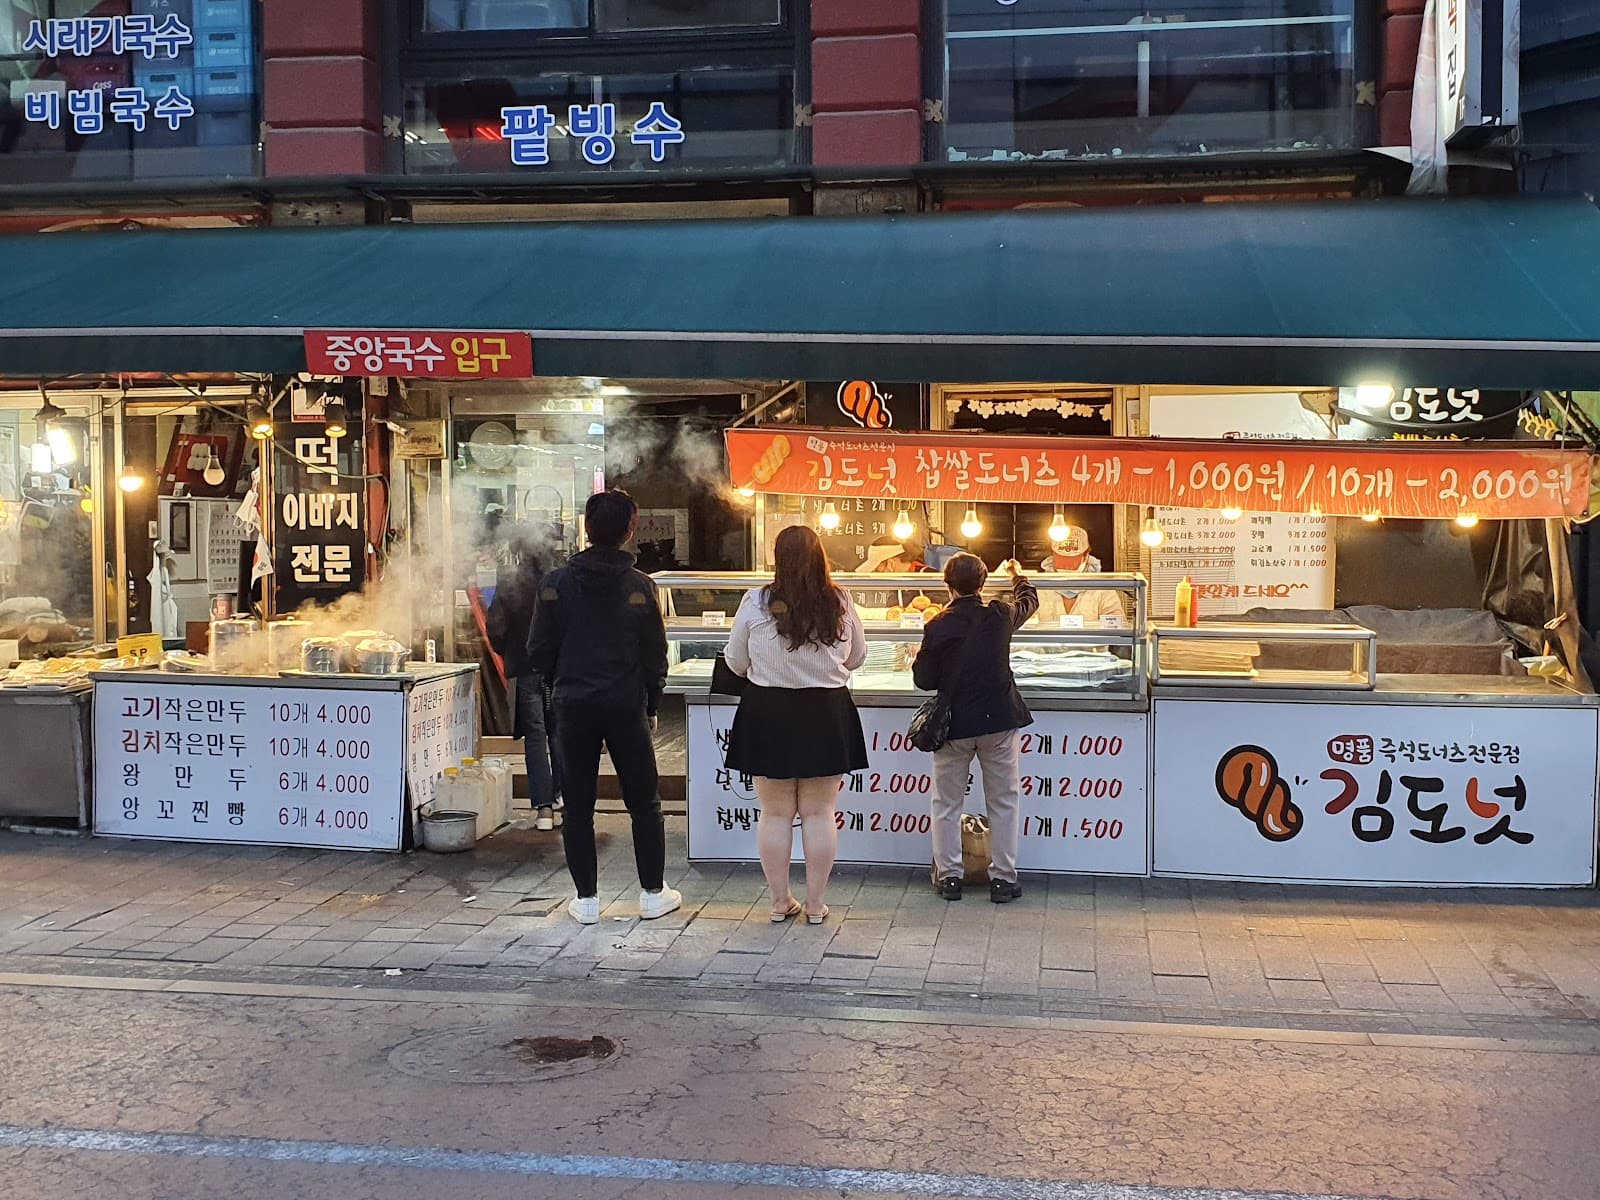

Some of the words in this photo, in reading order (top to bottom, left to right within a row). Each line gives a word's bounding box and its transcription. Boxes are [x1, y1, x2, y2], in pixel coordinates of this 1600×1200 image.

[23, 14, 193, 59] 시래기국수
[324, 336, 445, 372] 중앙국수
[450, 337, 512, 373] 입구
[295, 436, 339, 486] 떡
[805, 455, 897, 494] 김도넛
[915, 449, 1059, 491] 찹쌀도너츠
[1071, 454, 1121, 487] 4개
[1165, 458, 1286, 501] 1,000원
[1326, 465, 1393, 498] 10개
[1439, 464, 1573, 506] 2,000원
[282, 492, 359, 530] 이바지
[290, 545, 352, 582] 전문
[120, 695, 248, 724] 고기작은만두
[268, 701, 309, 725] 10개
[316, 704, 372, 725] 4.000
[121, 729, 248, 758] 김치작은만두
[268, 737, 309, 760] 10개
[316, 738, 371, 760] 4.000
[872, 731, 914, 752] 1.00
[1019, 733, 1052, 755] 2개
[1060, 734, 1123, 757] 1.000
[1331, 738, 1373, 763] 명품
[1378, 737, 1521, 764] 즉석도너츠전문점
[278, 771, 309, 794] 6개
[315, 772, 370, 794] 4.000
[838, 773, 863, 793] 개
[869, 773, 932, 794] 2.000
[1019, 775, 1052, 797] 3개
[1058, 776, 1123, 798] 2.000
[278, 807, 308, 829] 6개
[315, 807, 369, 830] 4.000
[1319, 769, 1535, 844] 김도넛
[834, 811, 864, 832] 3개
[869, 812, 932, 834] 2.000
[1022, 815, 1052, 838] 1개
[1060, 817, 1124, 839] 1.500
